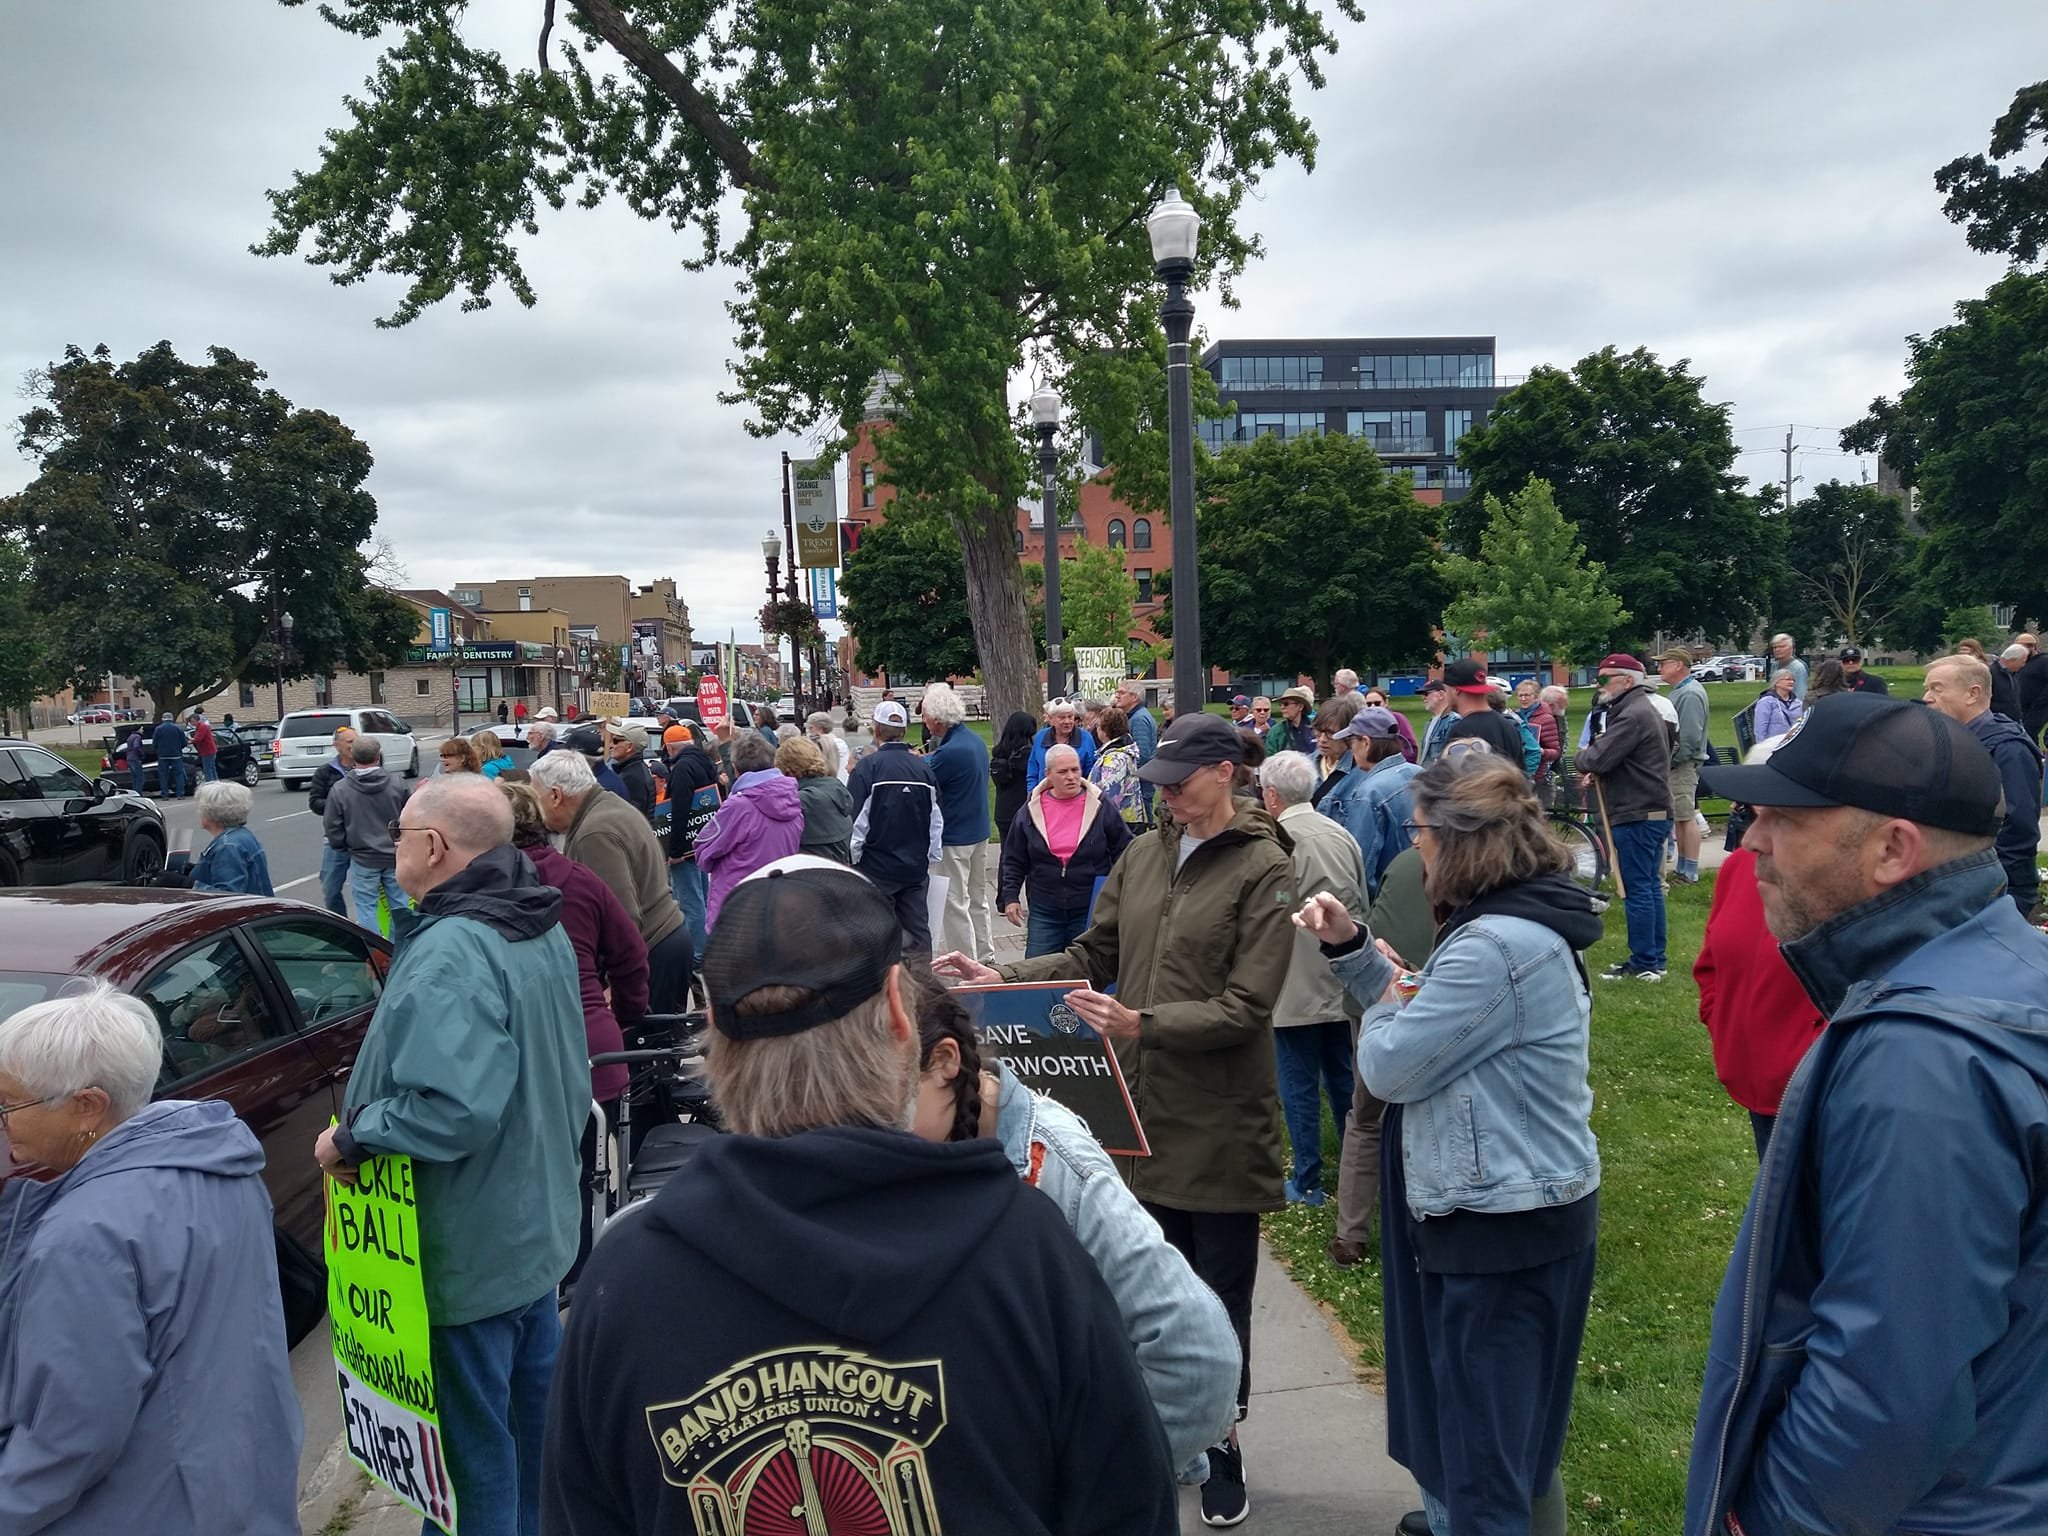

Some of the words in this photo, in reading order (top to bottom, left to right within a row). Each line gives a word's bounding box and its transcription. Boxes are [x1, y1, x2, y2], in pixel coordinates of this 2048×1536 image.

[796, 481, 818, 489] CHANGE
[803, 538, 833, 547] TRENT
[463, 650, 512, 659] DENTISTRY
[700, 682, 719, 695] STOP
[703, 697, 721, 705] PAVING
[973, 1024, 1032, 1045] SAVE
[339, 1202, 416, 1267] BALL
[348, 1282, 396, 1335] OUR
[660, 1377, 758, 1467] BANJO
[757, 1361, 934, 1420] HANGOUT
[716, 1399, 801, 1445] PLAYERS
[804, 1397, 871, 1419] UNION
